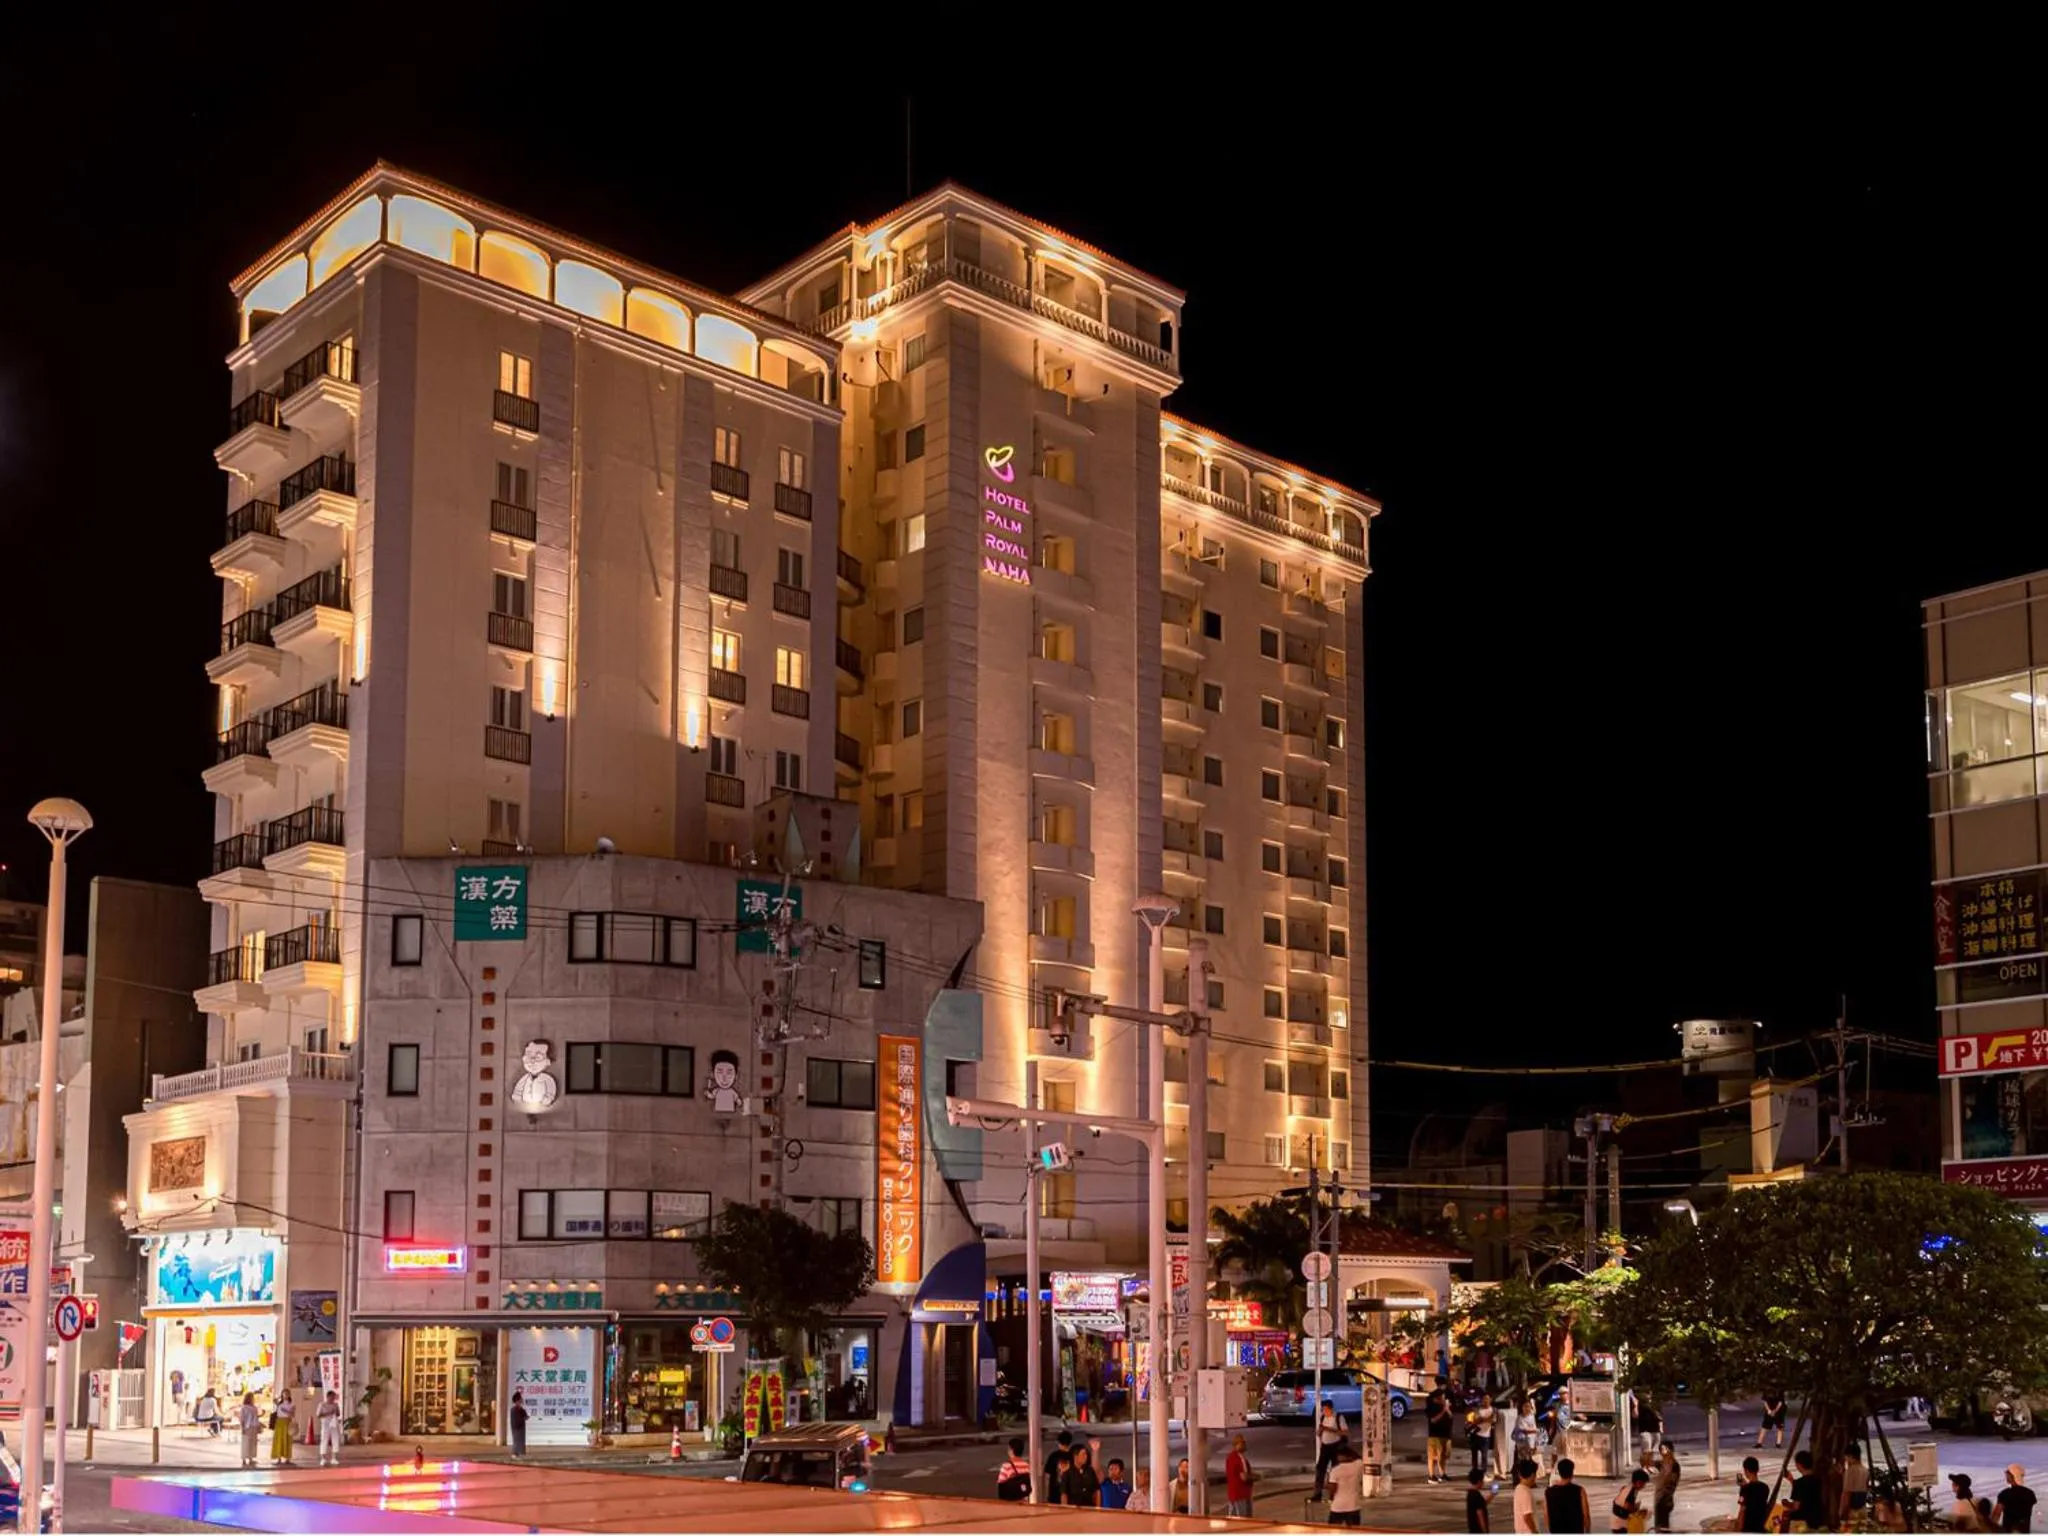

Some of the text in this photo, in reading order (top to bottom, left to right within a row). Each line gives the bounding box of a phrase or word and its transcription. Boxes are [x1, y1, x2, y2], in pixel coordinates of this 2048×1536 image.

[985, 486, 1030, 514] HOTEL
[985, 510, 1022, 534] PALM
[985, 534, 1028, 560] ROYAL
[984, 557, 1030, 584] NAHA
[460, 875, 521, 901] 漢方
[1999, 963, 2038, 981] OPEN
[1954, 1041, 1973, 1069] P
[2000, 1048, 2026, 1063] 地下
[2014, 1182, 2043, 1192] PLAZA
[515, 1368, 588, 1383] 大天堂薬局
